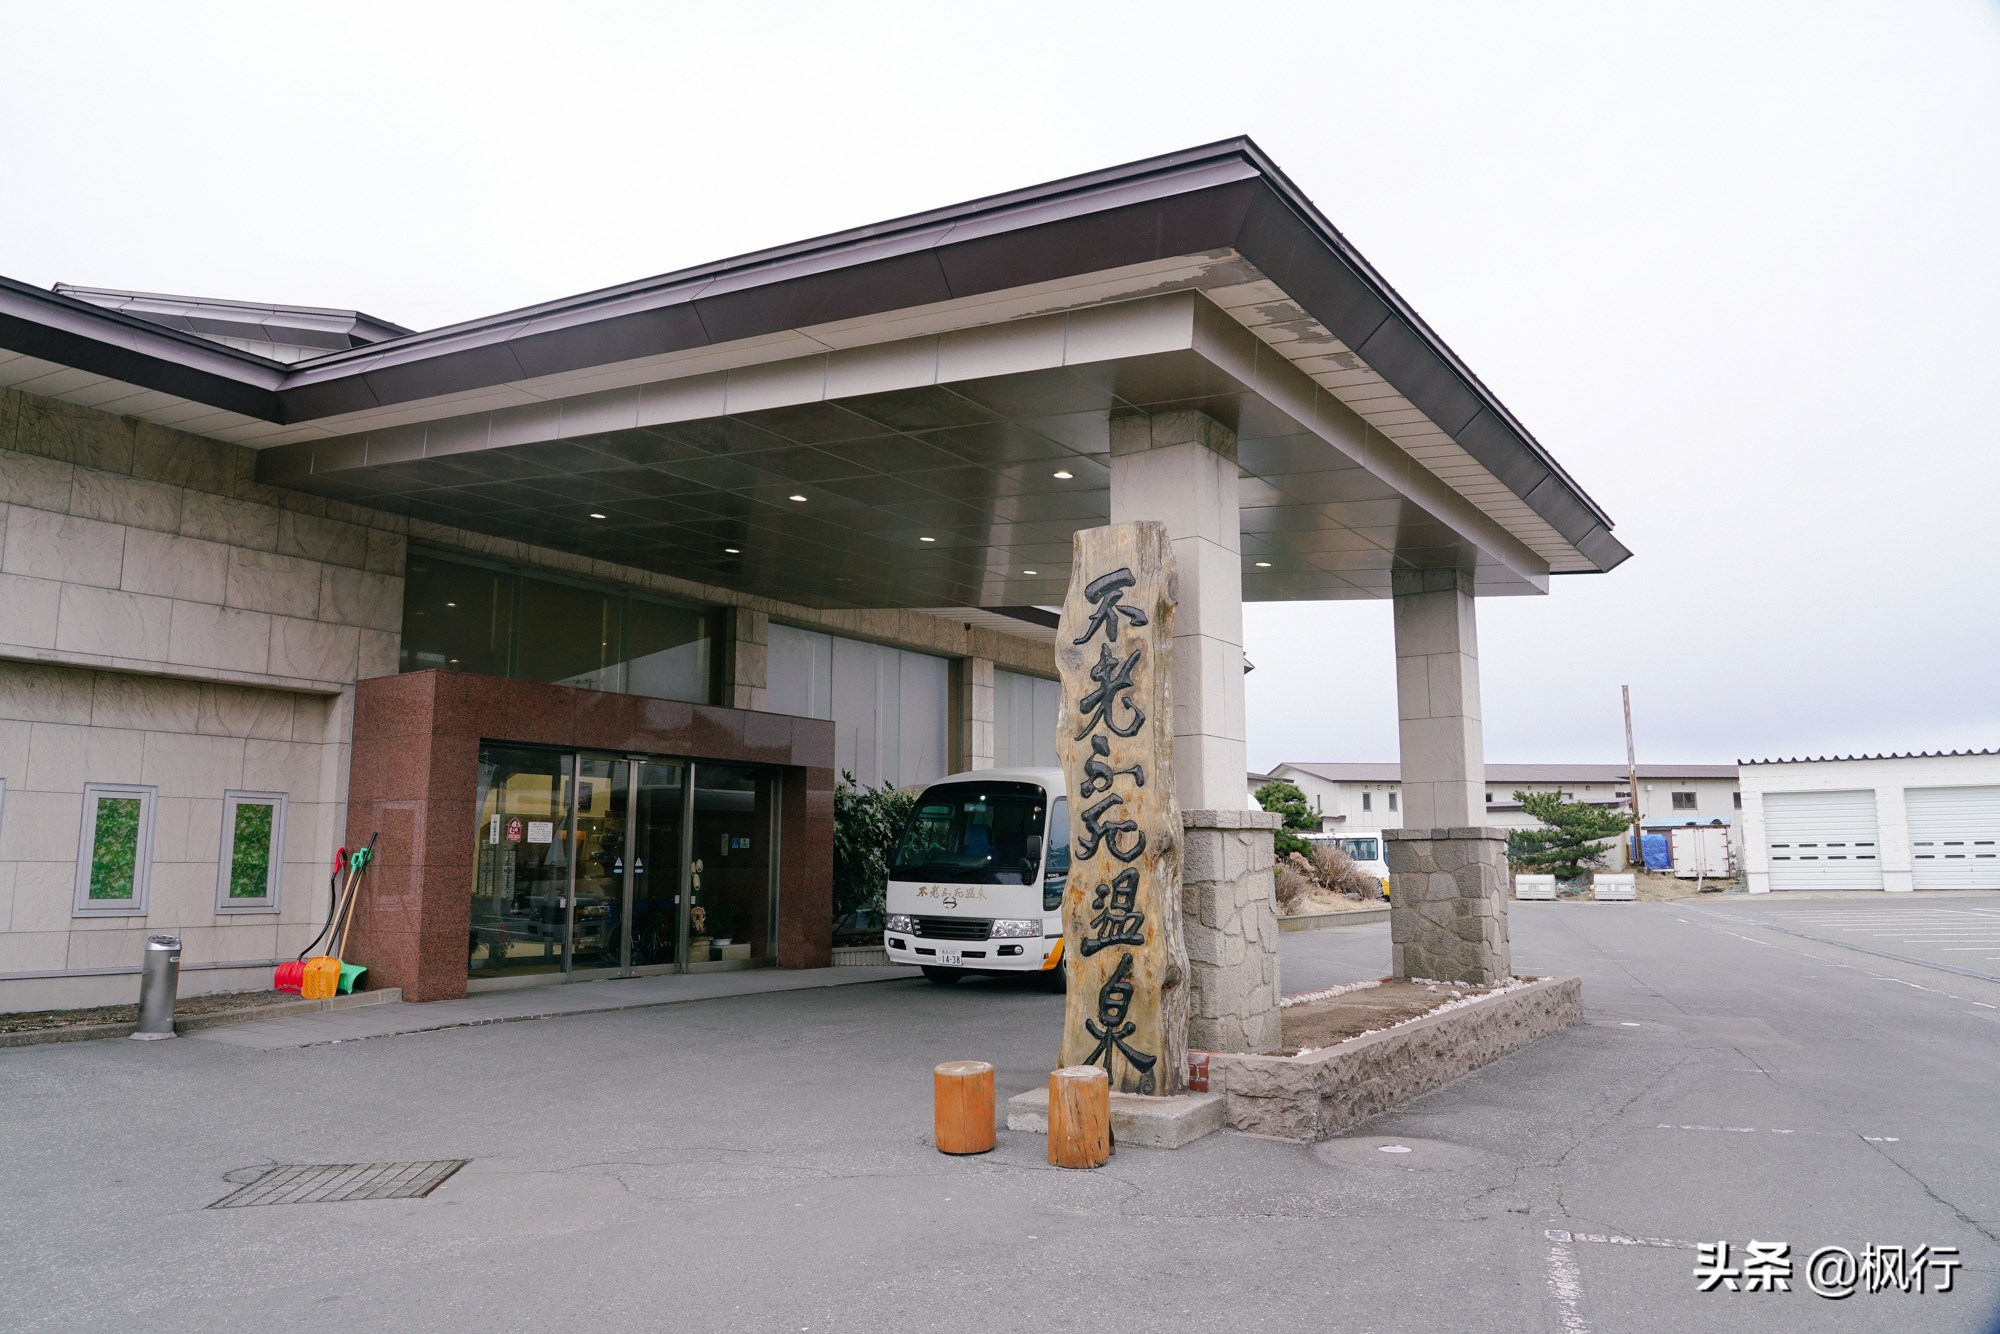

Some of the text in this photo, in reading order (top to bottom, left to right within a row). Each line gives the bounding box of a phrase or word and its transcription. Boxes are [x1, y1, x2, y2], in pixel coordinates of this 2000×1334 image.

[1073, 567, 1157, 1085] 不老ふ死温泉
